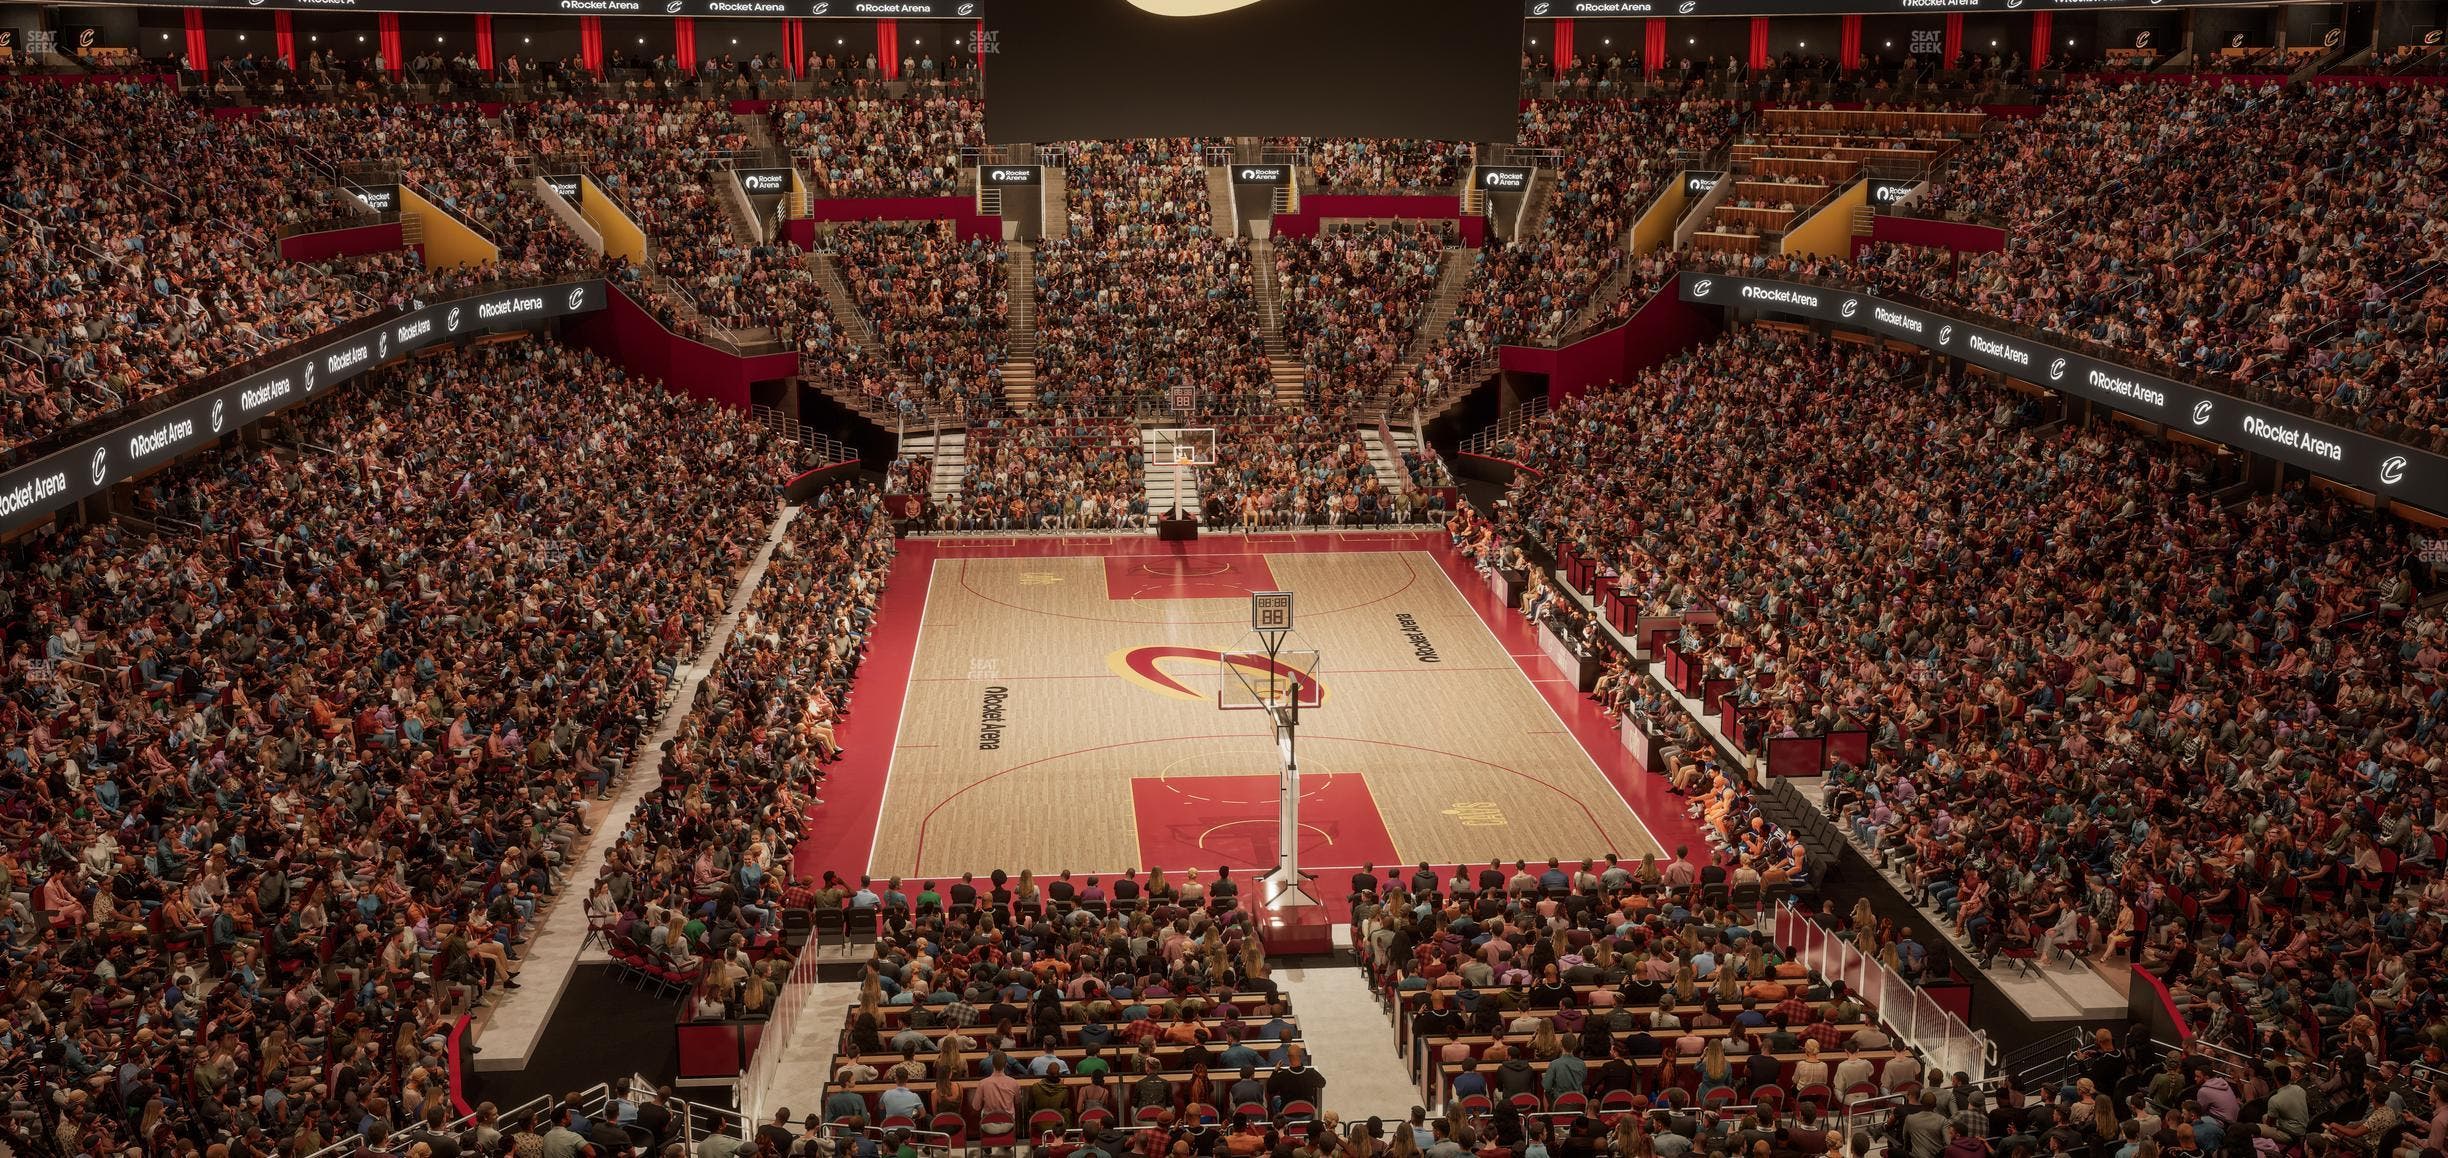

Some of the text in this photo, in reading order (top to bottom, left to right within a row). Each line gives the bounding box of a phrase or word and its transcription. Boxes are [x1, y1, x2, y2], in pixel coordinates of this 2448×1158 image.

[571, 0, 639, 9] Rocket Arena
[719, 3, 784, 11] Rocket Arena
[866, 4, 931, 12] Rocket Arena
[1586, 3, 1651, 11] Rocket Arena
[486, 298, 543, 317] Rocket Arena
[1753, 286, 1818, 306] Rocket Arena
[402, 319, 431, 341] Rocket Arena
[1880, 308, 1922, 332] Rocket Arena
[333, 345, 368, 371] Rocket Arena
[1976, 336, 2029, 365] Rocket Arena
[248, 378, 290, 409] Rocket Arena
[2098, 372, 2164, 406] Rocket Arena
[138, 419, 193, 456] Rocket Arena
[2255, 418, 2342, 461] Rocket Arena
[35, 472, 67, 501] Arena
[1262, 609, 1283, 625] 88
[1395, 613, 1438, 656] Rocket Arena
[979, 693, 1009, 751] Rocket Arena
